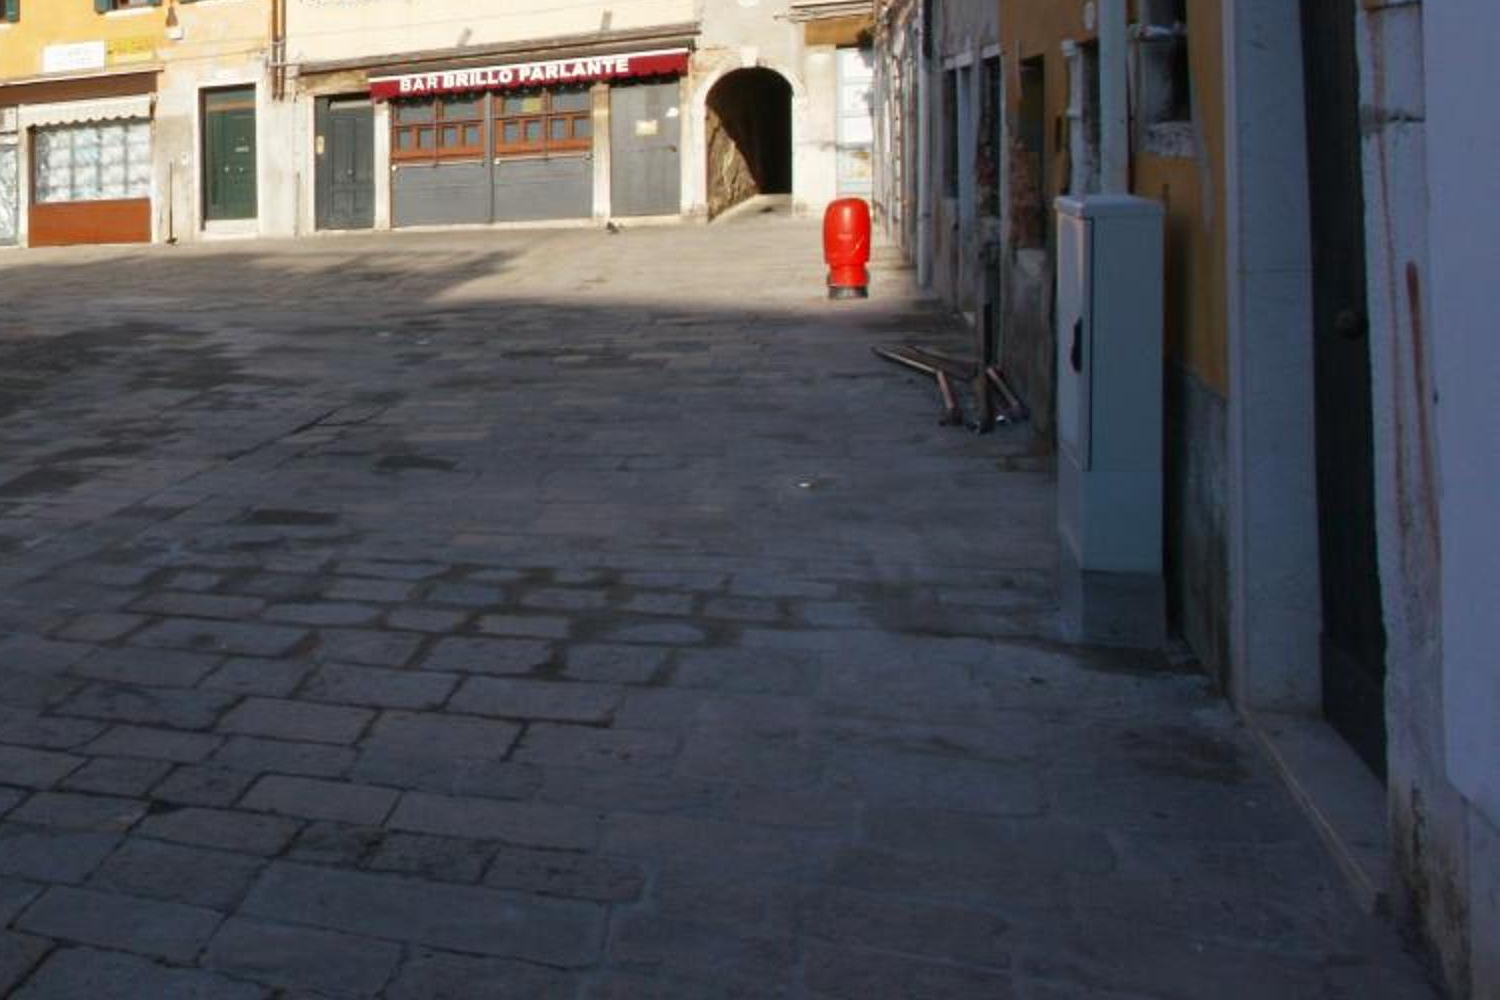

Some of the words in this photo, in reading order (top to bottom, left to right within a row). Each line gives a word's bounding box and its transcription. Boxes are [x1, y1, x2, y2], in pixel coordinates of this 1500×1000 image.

[399, 76, 438, 92] BAR
[442, 69, 514, 88] BRILLO
[519, 57, 629, 81] PARLANTE
